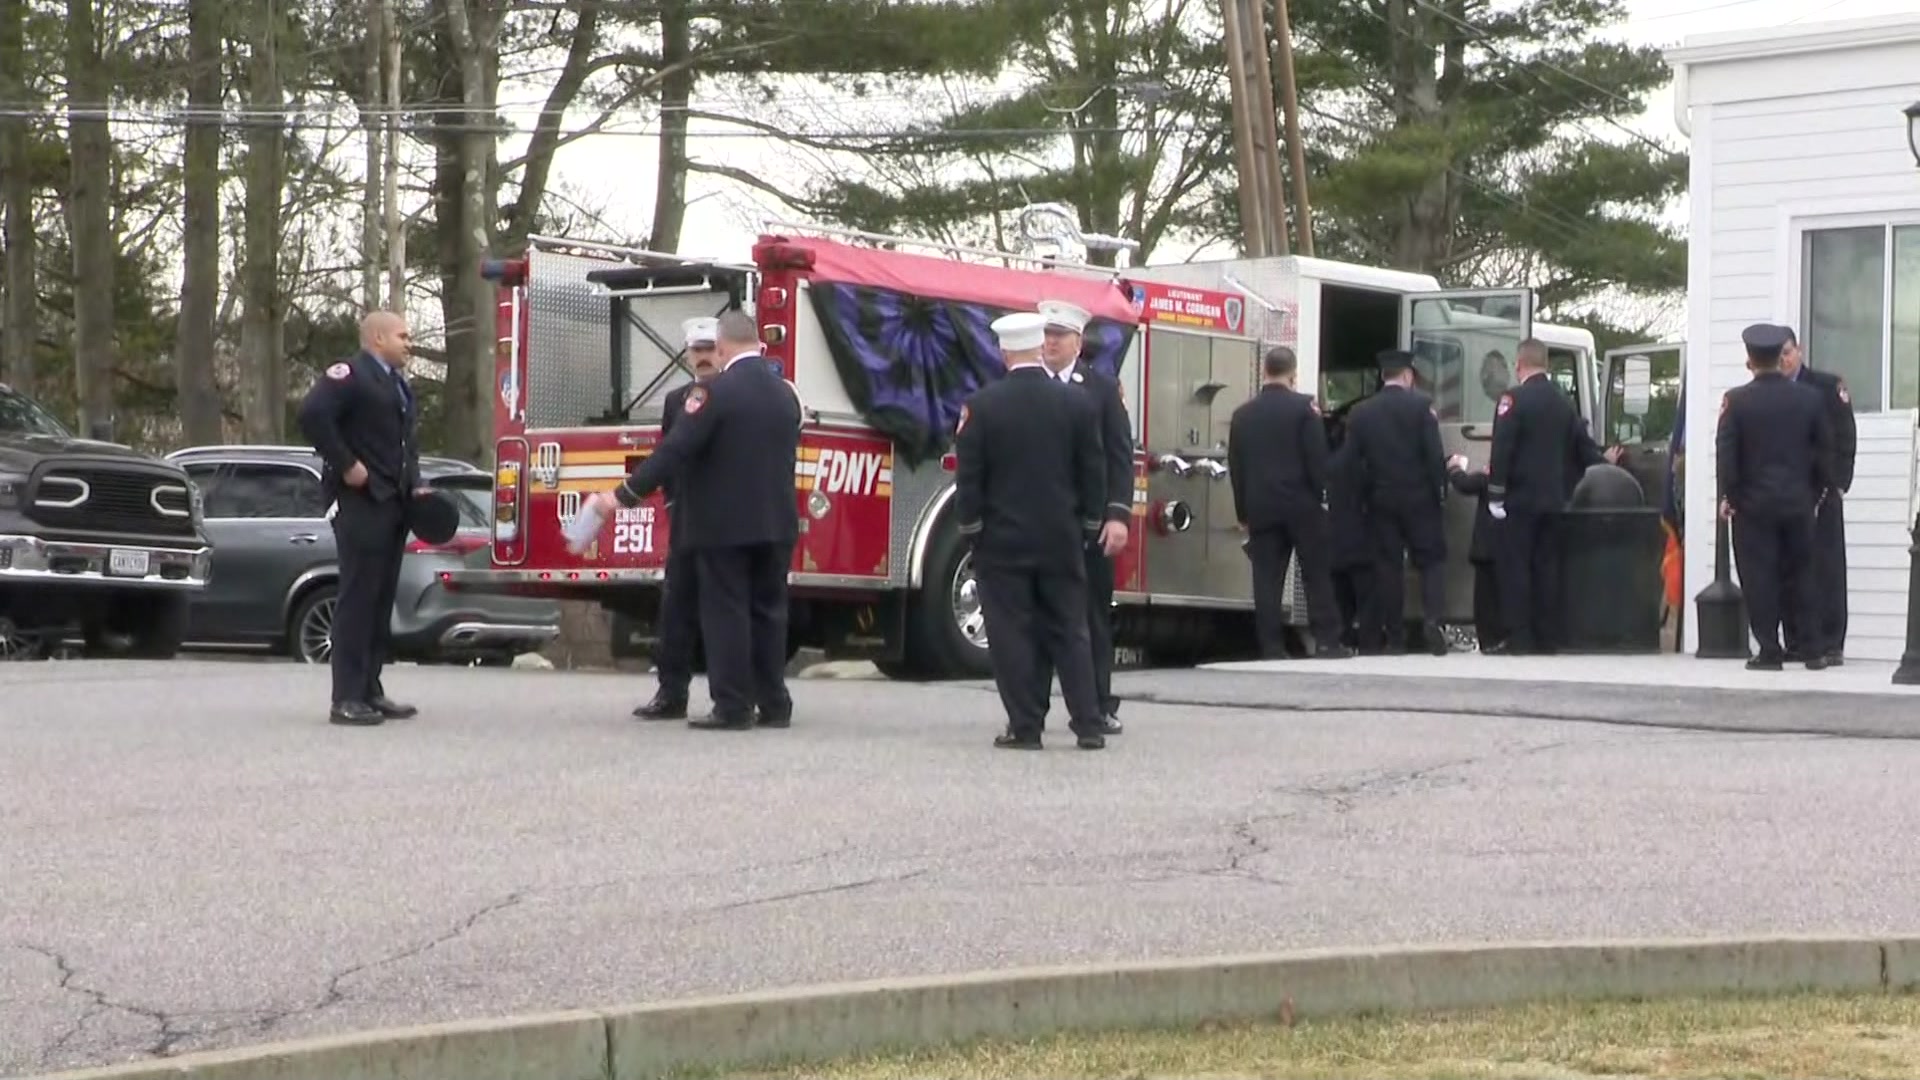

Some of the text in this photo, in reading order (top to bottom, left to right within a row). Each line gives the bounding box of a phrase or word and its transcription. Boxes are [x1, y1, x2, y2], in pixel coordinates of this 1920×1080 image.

[1150, 296, 1174, 311] JAMES
[1185, 301, 1221, 318] CORRIGAN
[813, 448, 883, 495] FDNY
[615, 507, 655, 523] ENGINE
[614, 523, 653, 553] 291
